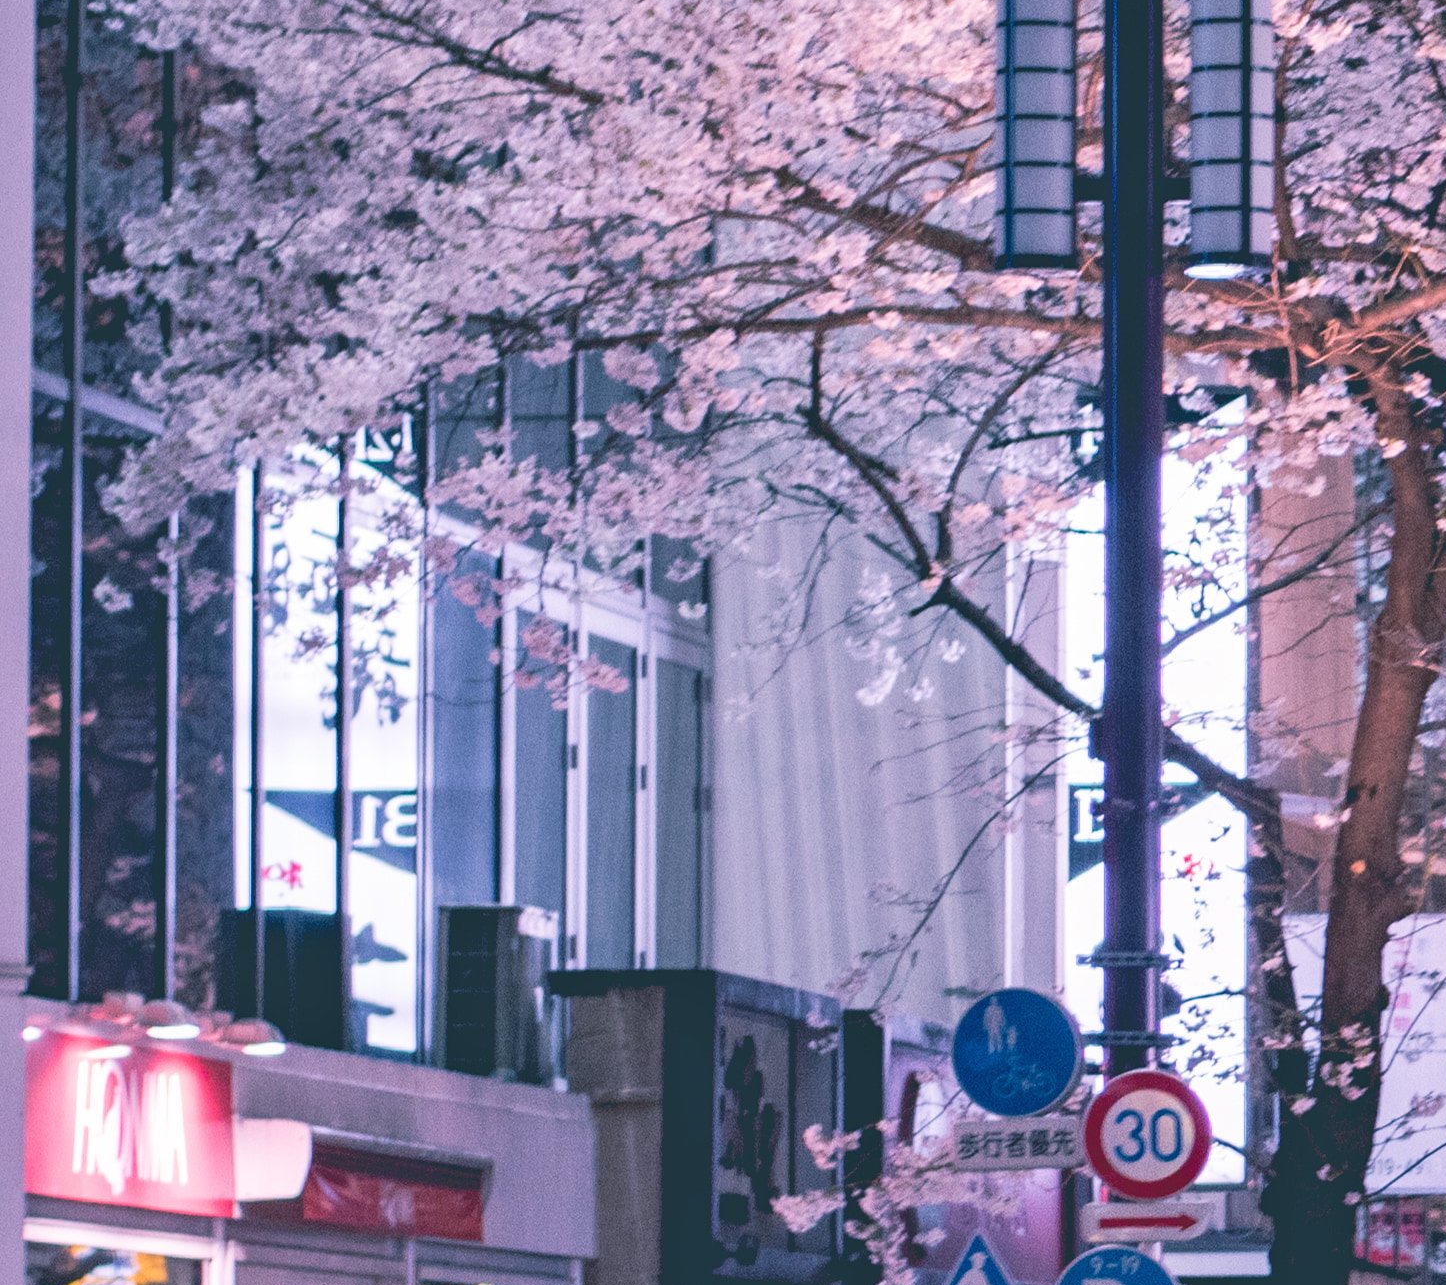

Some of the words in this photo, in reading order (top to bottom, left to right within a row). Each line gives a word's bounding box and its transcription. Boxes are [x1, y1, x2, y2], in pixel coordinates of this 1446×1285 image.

[958, 1126, 1076, 1160] 歩行者優先
[1114, 1109, 1183, 1164] 30
